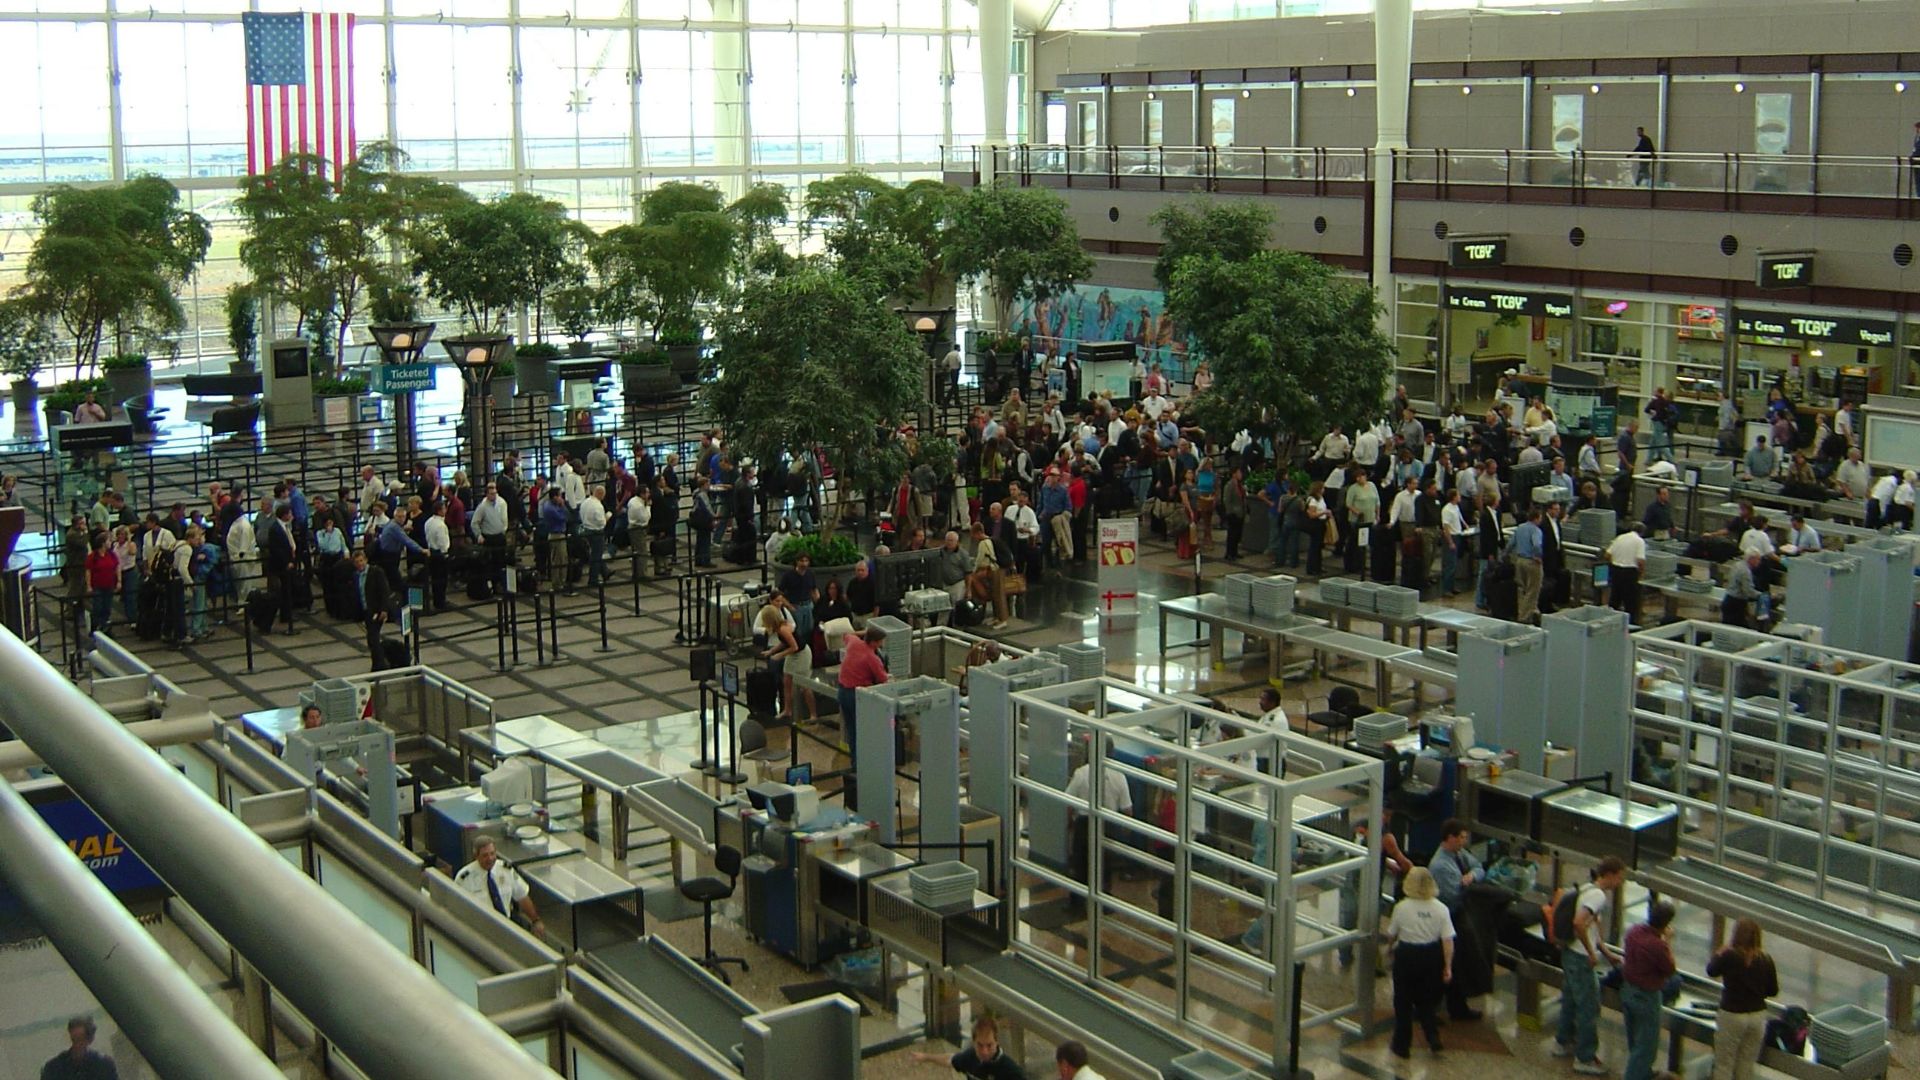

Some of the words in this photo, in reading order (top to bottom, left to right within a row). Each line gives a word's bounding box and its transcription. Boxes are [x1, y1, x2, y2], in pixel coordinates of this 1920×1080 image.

[1462, 297, 1486, 307] Cream
[1545, 303, 1571, 316] Yogurt
[1738, 319, 1752, 330] Ice
[1754, 320, 1785, 333] Cream
[1859, 329, 1892, 344] Yogurt
[391, 368, 429, 379] Ticketed
[385, 379, 435, 390] Passengers
[1102, 527, 1118, 539] Stop
